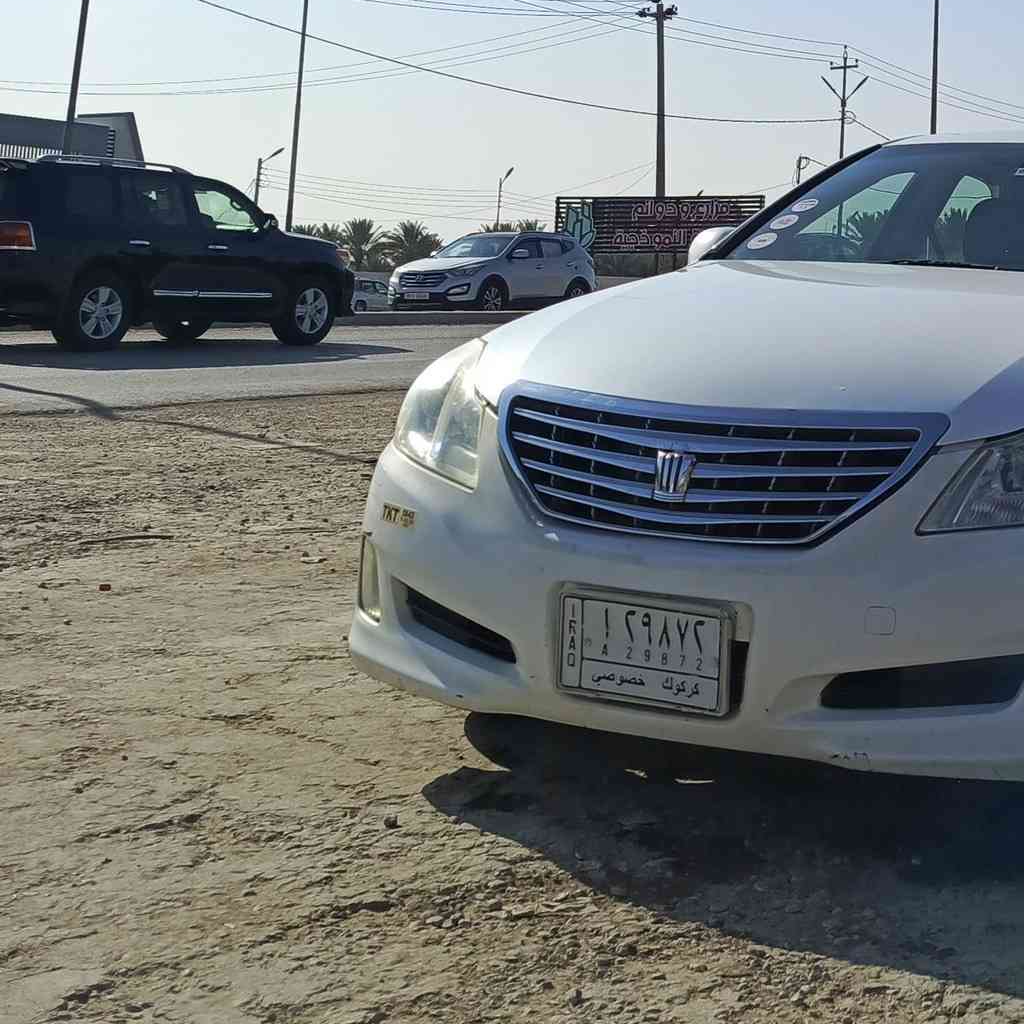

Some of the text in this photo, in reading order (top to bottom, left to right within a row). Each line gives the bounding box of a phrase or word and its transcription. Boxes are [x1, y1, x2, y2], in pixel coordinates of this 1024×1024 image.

[567, 603, 576, 667] IRAQ
[625, 646, 703, 672] 29872
[592, 672, 701, 698] كركوك خصوصي
